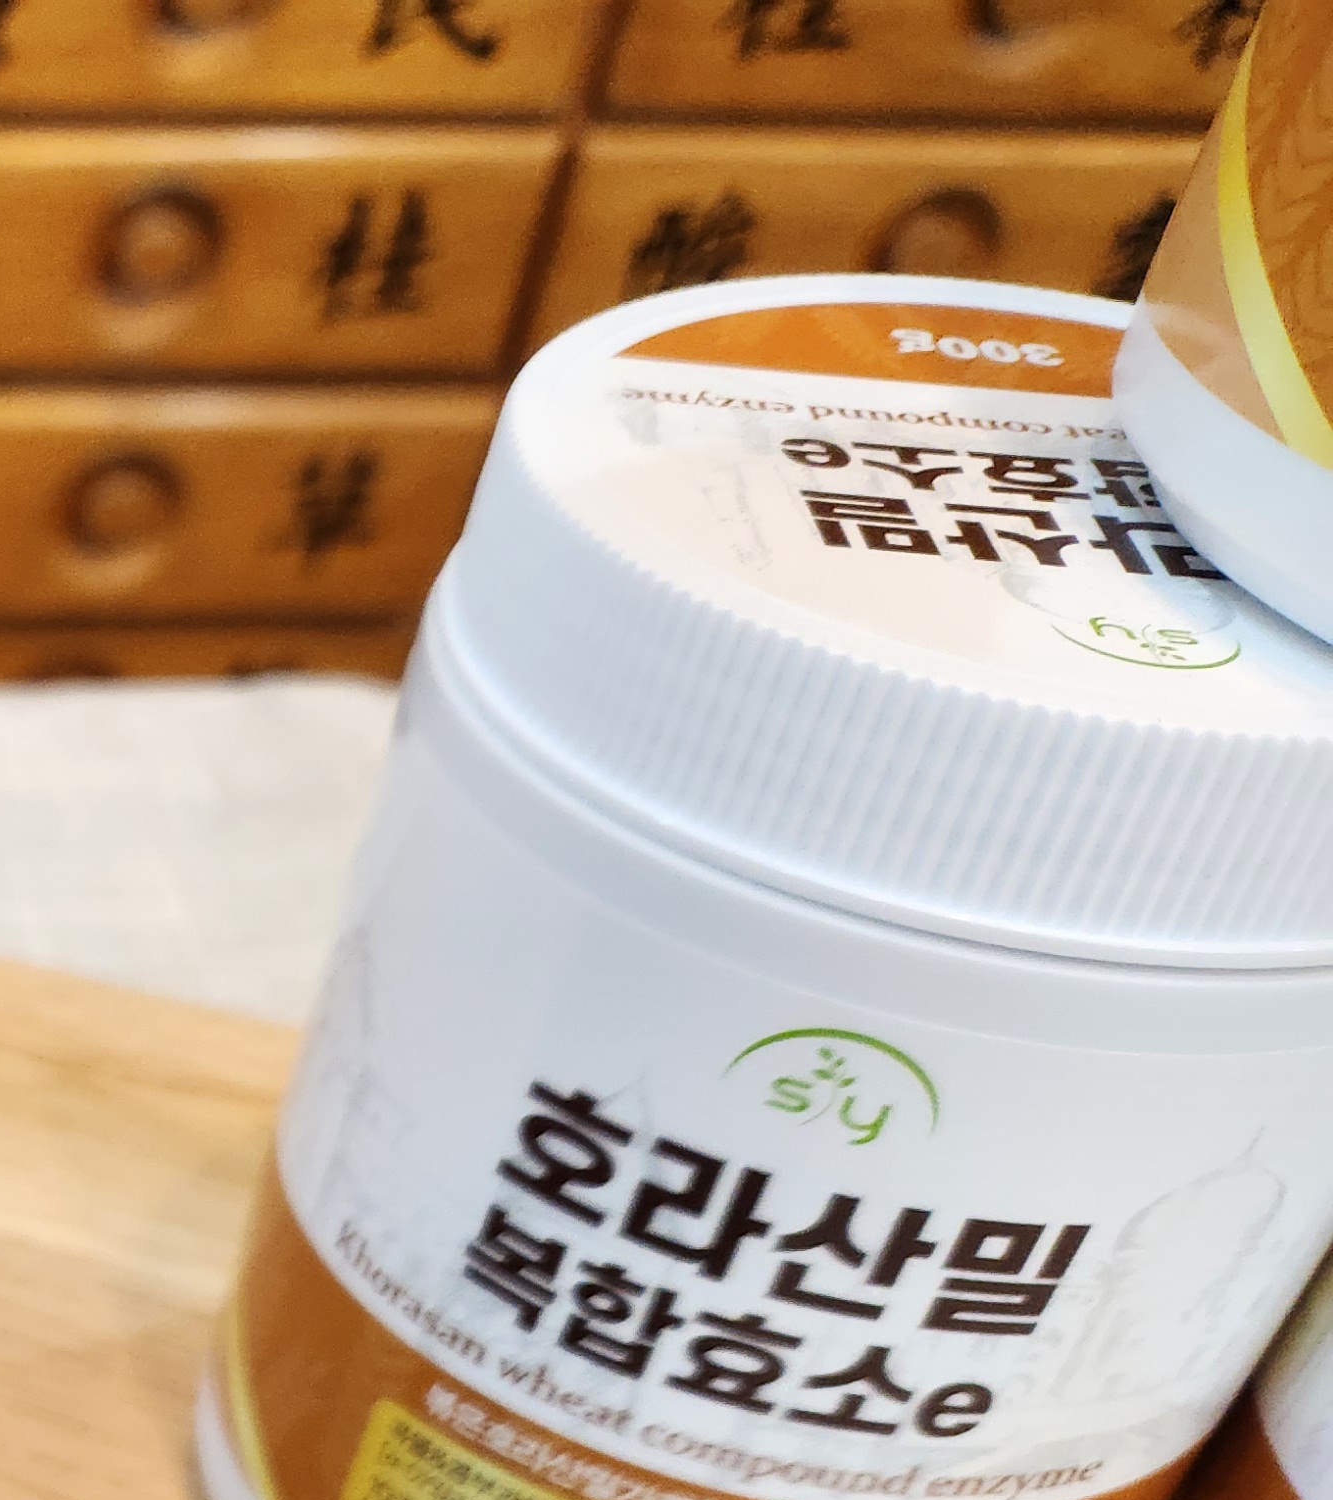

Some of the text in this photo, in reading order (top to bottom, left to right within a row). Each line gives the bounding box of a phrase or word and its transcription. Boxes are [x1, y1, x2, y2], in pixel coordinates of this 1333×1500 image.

[620, 387, 796, 415] enzyme
[889, 327, 1065, 368] 200g
[809, 405, 1053, 438] compound
[495, 1079, 1096, 1338] 호라산밀
[336, 1219, 487, 1365] Khorasan
[498, 1356, 632, 1435] wheat
[639, 1420, 919, 1497] compound
[463, 1203, 994, 1439] 복합효소e
